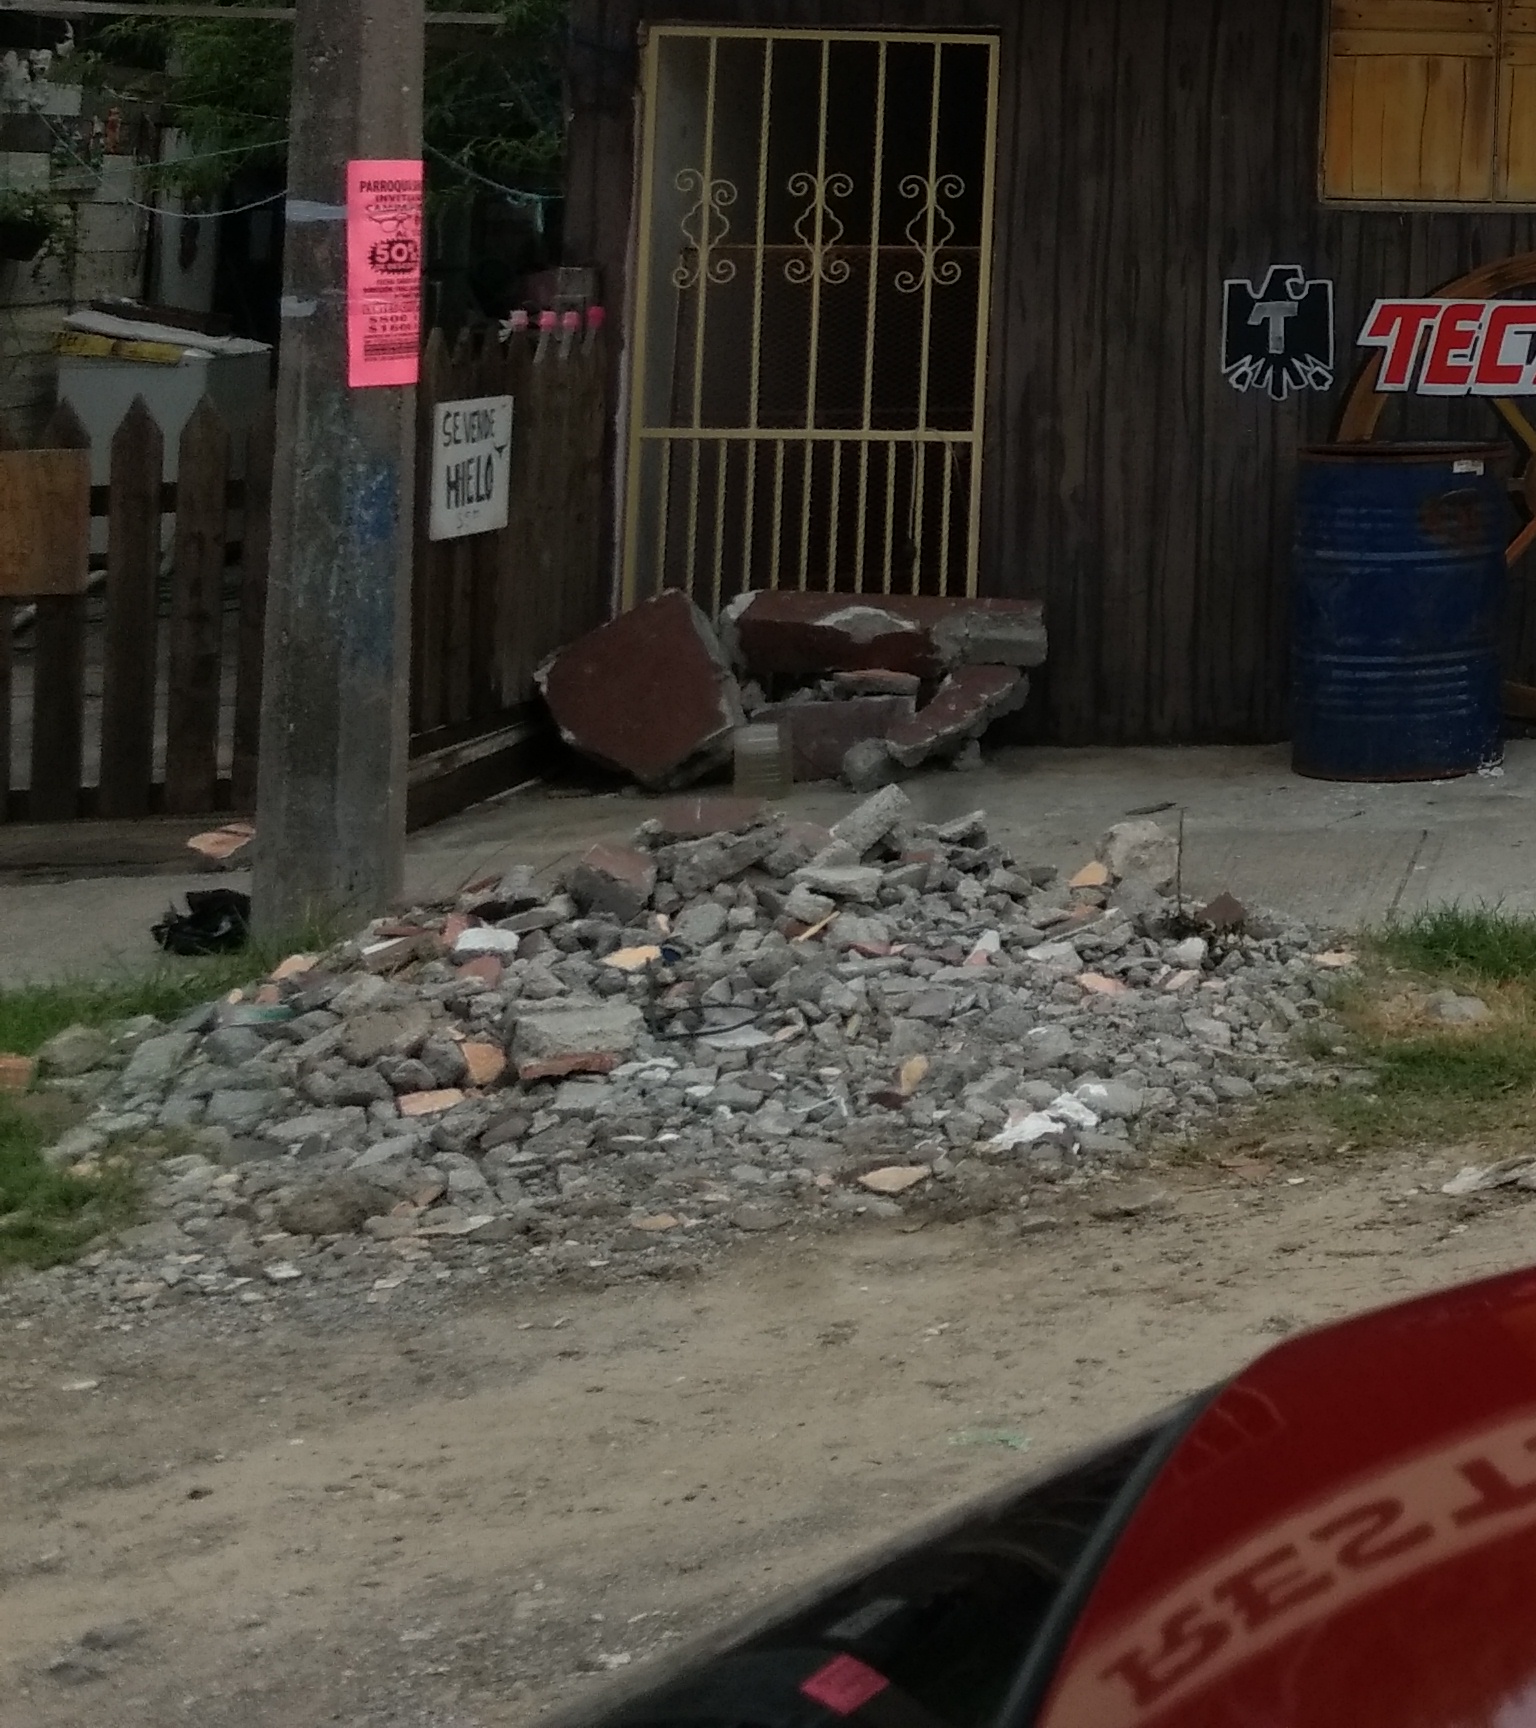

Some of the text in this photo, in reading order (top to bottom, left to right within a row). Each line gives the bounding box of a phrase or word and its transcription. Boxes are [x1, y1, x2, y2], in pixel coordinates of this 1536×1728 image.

[442, 408, 496, 447] SE VENDE
[446, 453, 494, 510] HIELO
